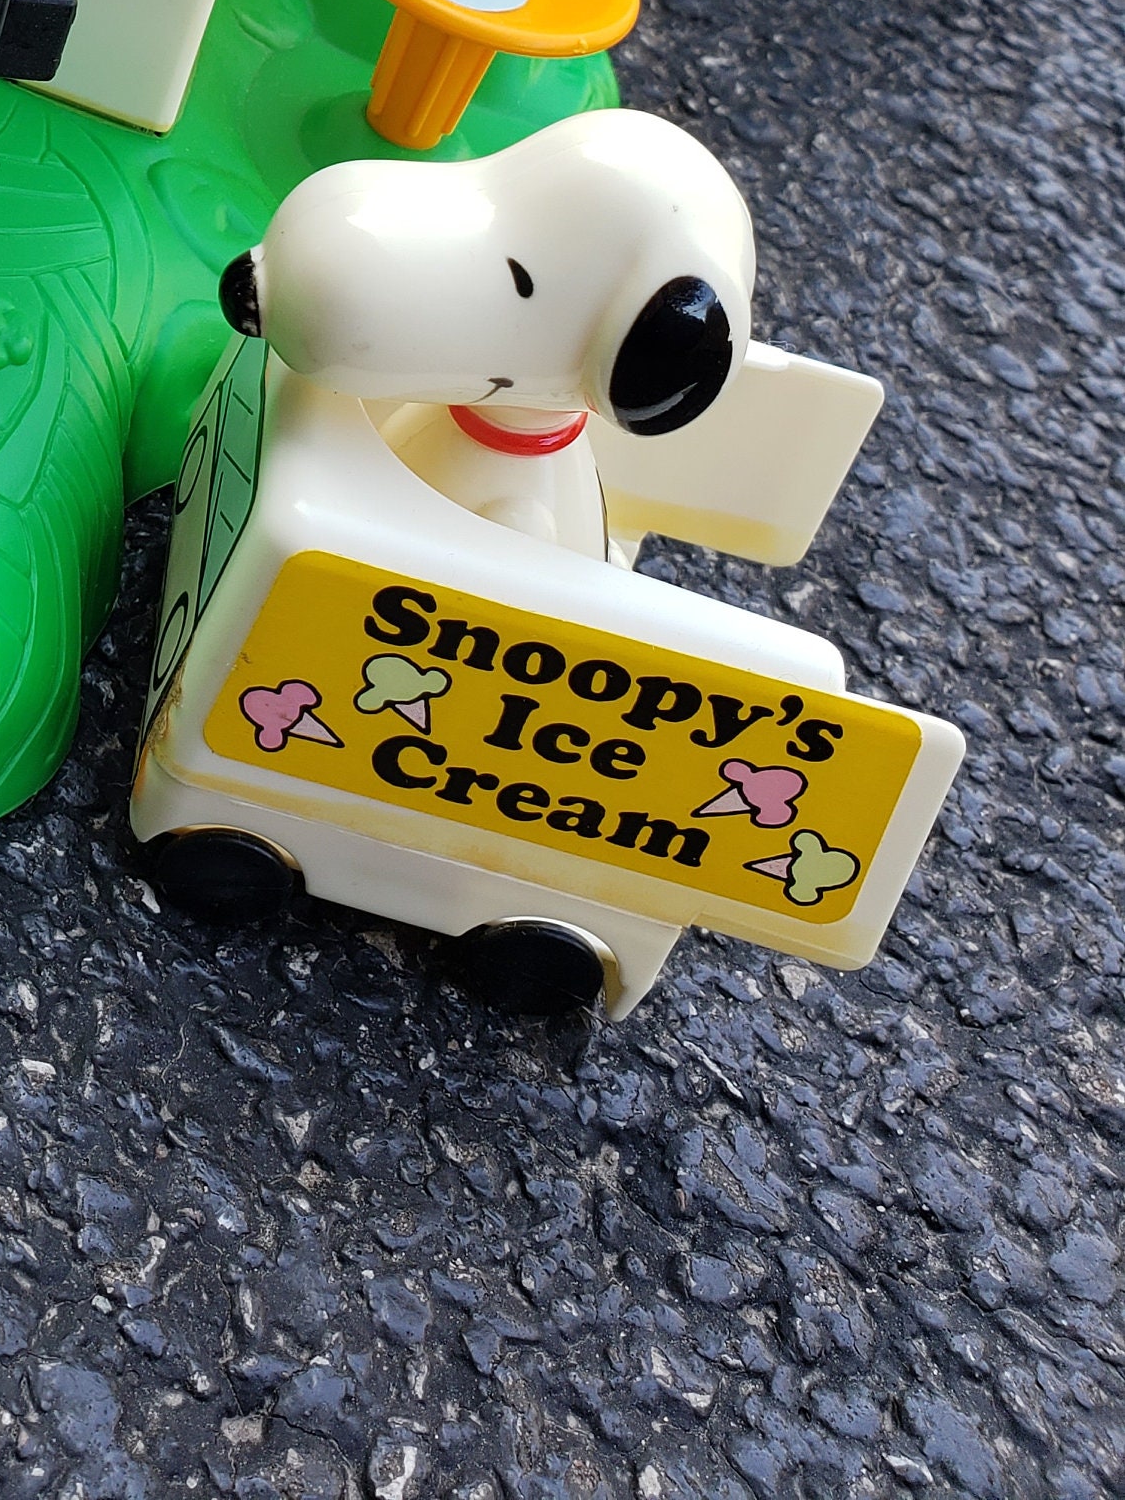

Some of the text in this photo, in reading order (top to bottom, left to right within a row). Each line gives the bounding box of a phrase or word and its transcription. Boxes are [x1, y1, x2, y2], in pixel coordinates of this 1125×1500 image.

[363, 585, 843, 763] Snoopy's
[483, 694, 646, 781] Ice
[372, 735, 711, 869] Cream
